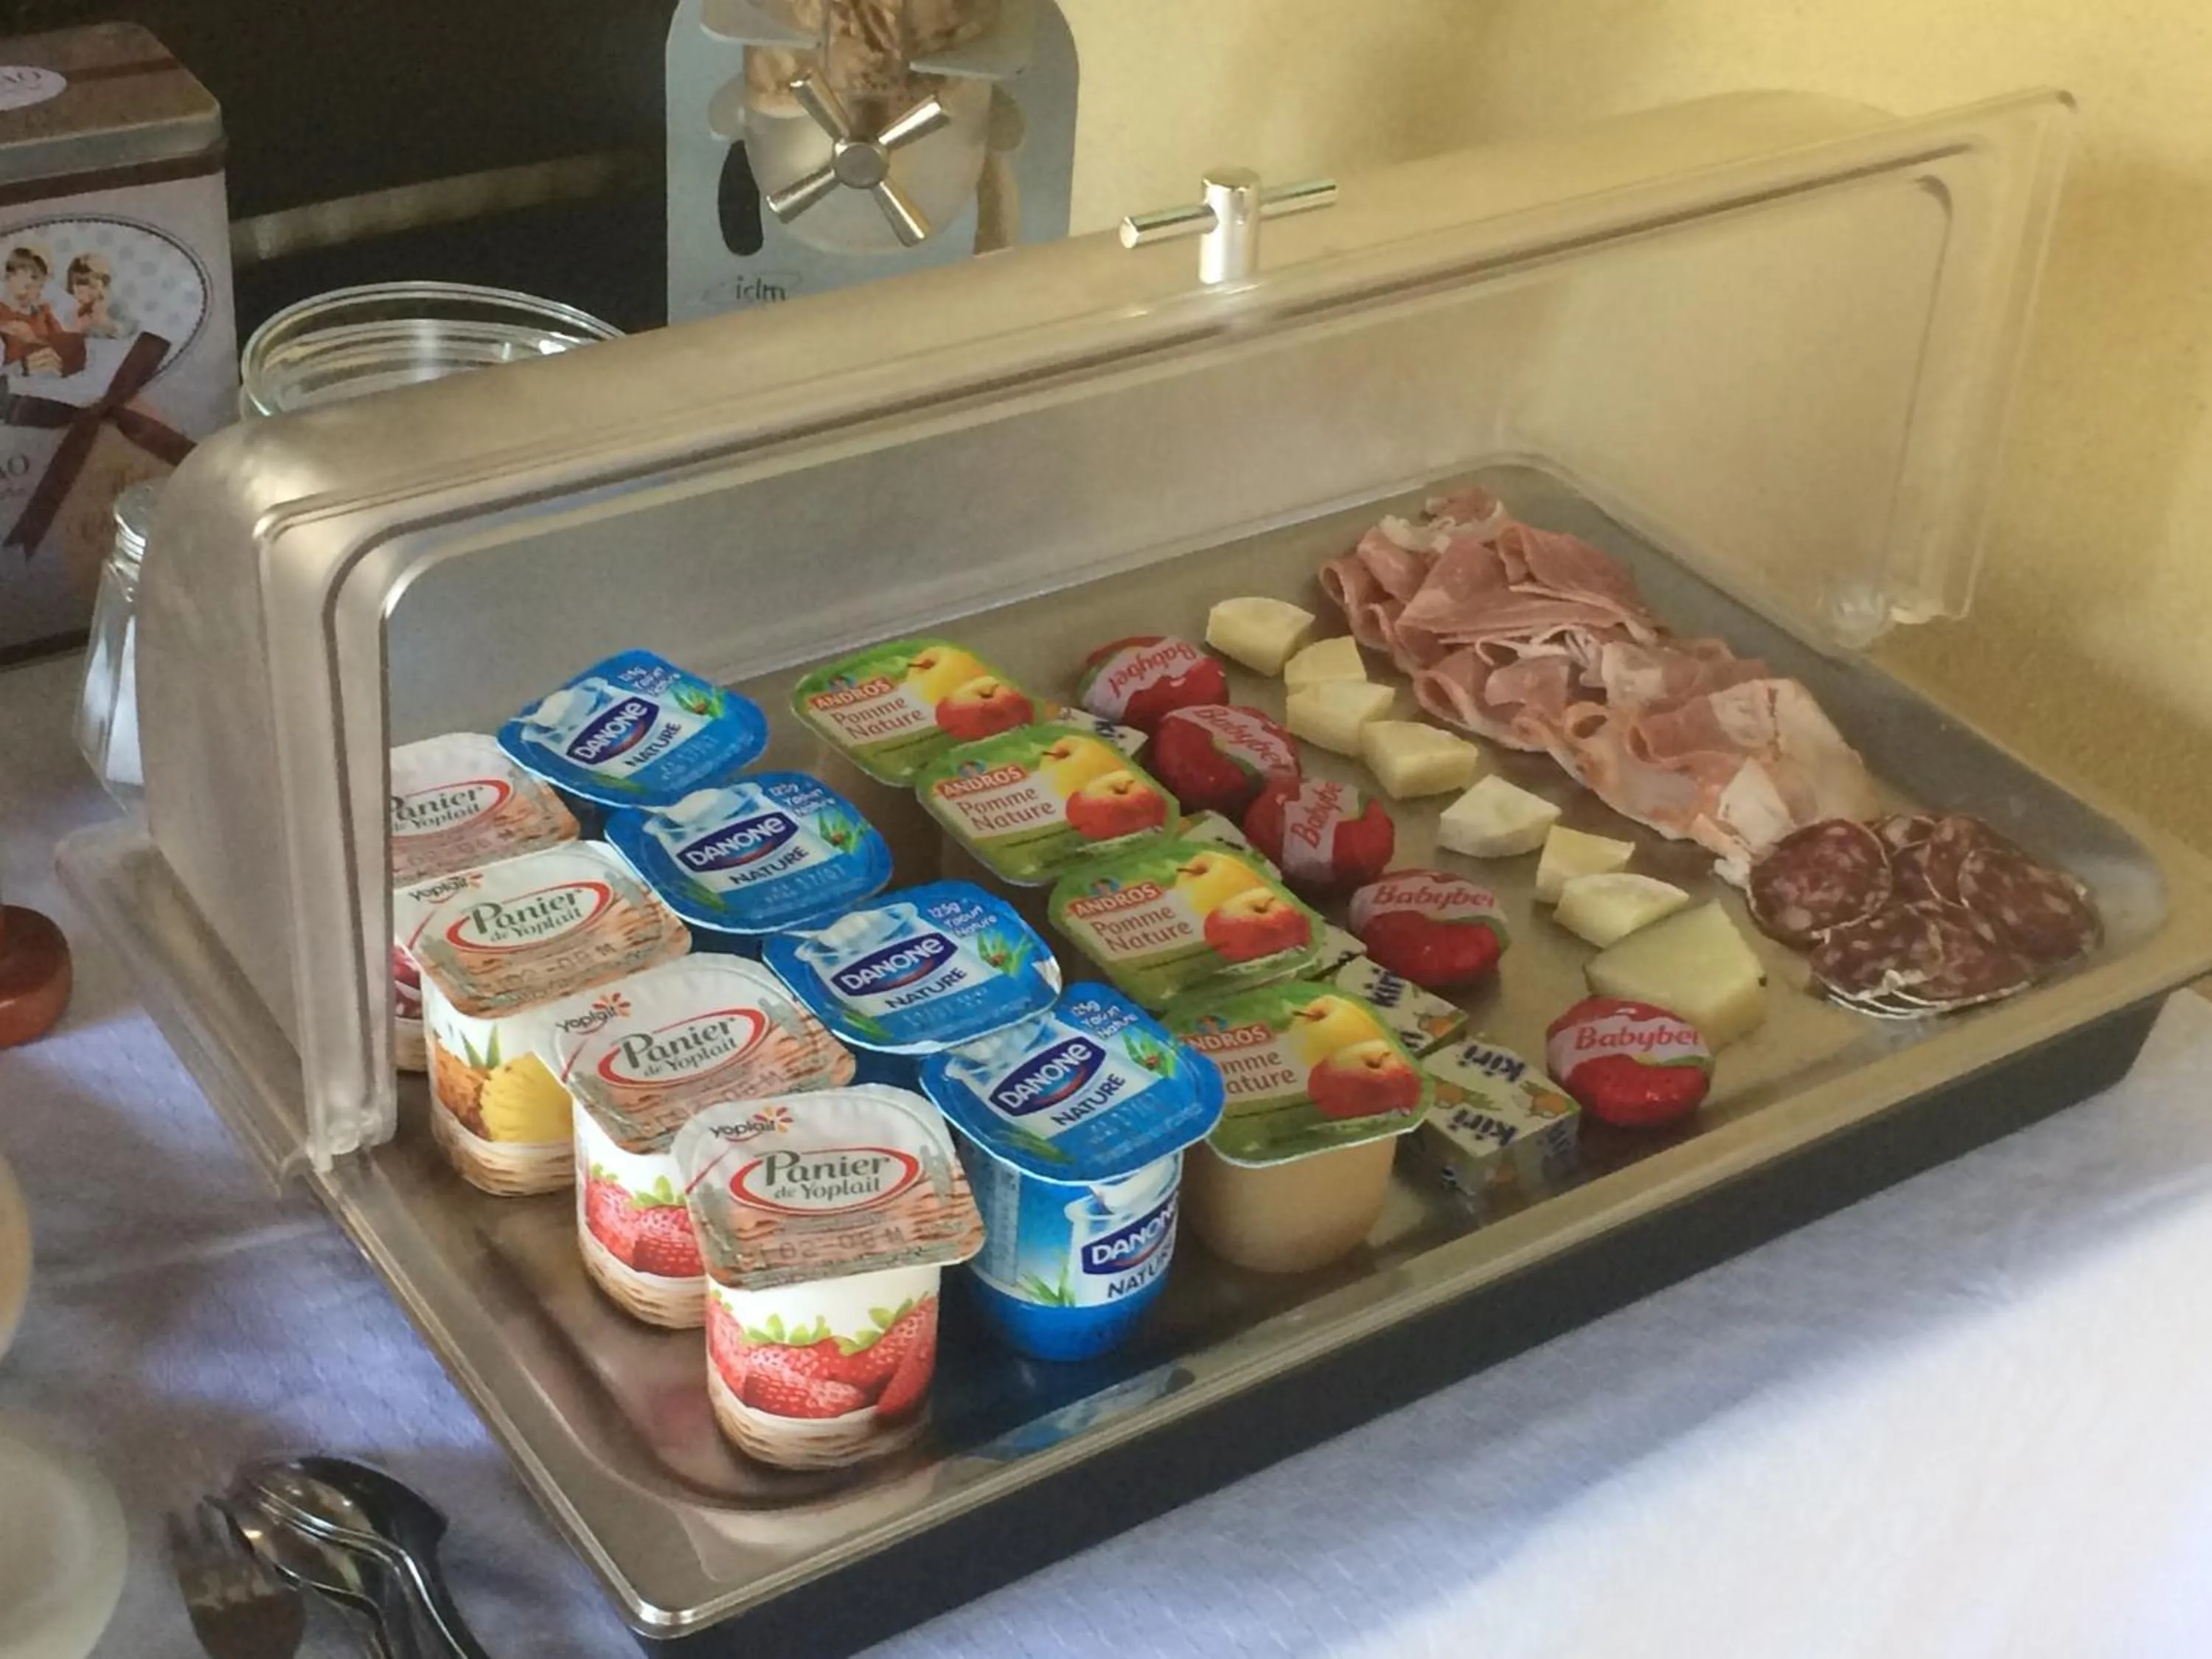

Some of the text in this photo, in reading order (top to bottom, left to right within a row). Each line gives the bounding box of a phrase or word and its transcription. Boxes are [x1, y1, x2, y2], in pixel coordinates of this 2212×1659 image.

[815, 678, 892, 710] ANDROS
[831, 695, 907, 726] Pomme
[845, 709, 927, 741] Nature
[625, 722, 682, 768] NATURE
[940, 766, 1024, 799] ANDROS
[411, 803, 479, 830] Yoplait
[957, 786, 1040, 818] Pomme
[971, 799, 1057, 832] Nature
[728, 846, 810, 886] NATURE
[463, 890, 580, 934] Panier
[1074, 883, 1157, 917] ANDROS
[490, 907, 582, 944] de Yoplait
[1091, 904, 1177, 938] Pomme
[1105, 919, 1194, 953] Nature
[884, 967, 967, 1009] NATURE
[611, 1018, 731, 1069] Panier
[1185, 1026, 1267, 1051] NDROS
[643, 1037, 737, 1078] de Yoplait
[1220, 1051, 1282, 1075] mme
[1225, 1068, 1298, 1095] ature
[1051, 1072, 1126, 1127] NATURE
[756, 1149, 889, 1187] Panier
[773, 1179, 880, 1202] de Yoplait
